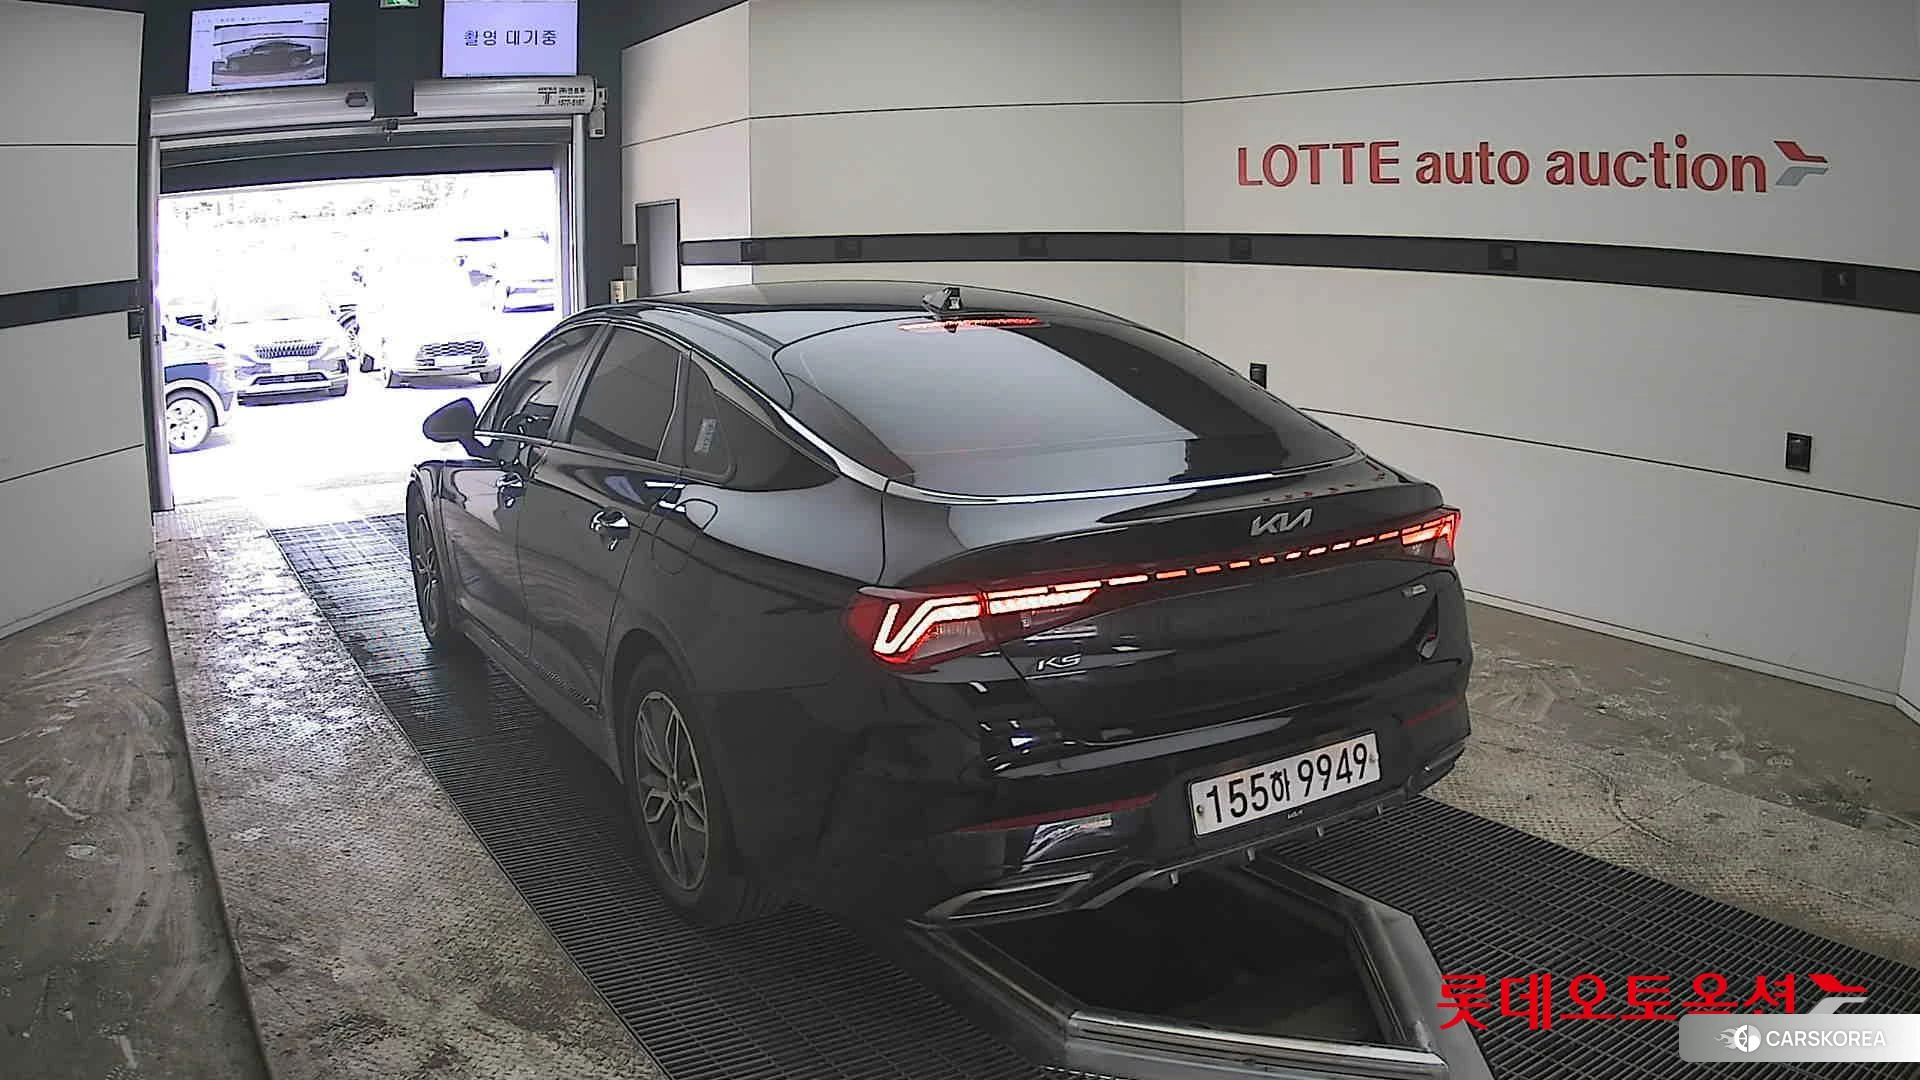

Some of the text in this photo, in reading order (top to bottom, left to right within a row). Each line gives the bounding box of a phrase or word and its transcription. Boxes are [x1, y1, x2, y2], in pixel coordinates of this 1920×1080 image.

[506, 30, 556, 46] 대기중
[1238, 134, 1767, 193] LOTTE auto auction
[1037, 653, 1081, 671] K5
[1206, 743, 1368, 823] 155하 9949
